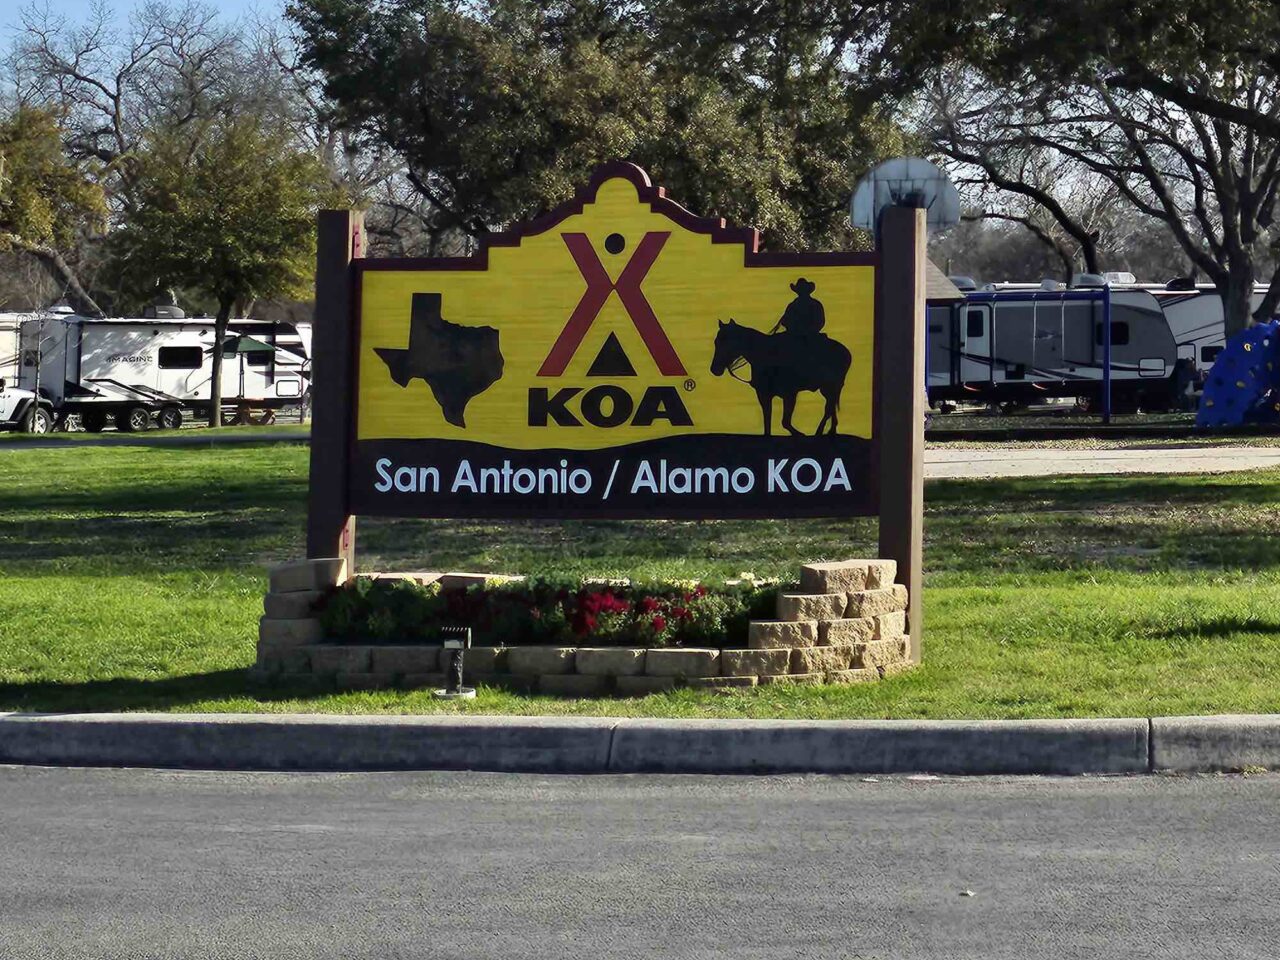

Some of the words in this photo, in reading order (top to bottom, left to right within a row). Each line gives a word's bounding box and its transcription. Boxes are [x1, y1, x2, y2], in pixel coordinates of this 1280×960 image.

[528, 385, 694, 428] KOA
[374, 458, 440, 492] San
[451, 459, 592, 494] Antonio
[602, 459, 620, 500] /
[630, 459, 755, 494] Alamo
[767, 457, 852, 492] KOA
